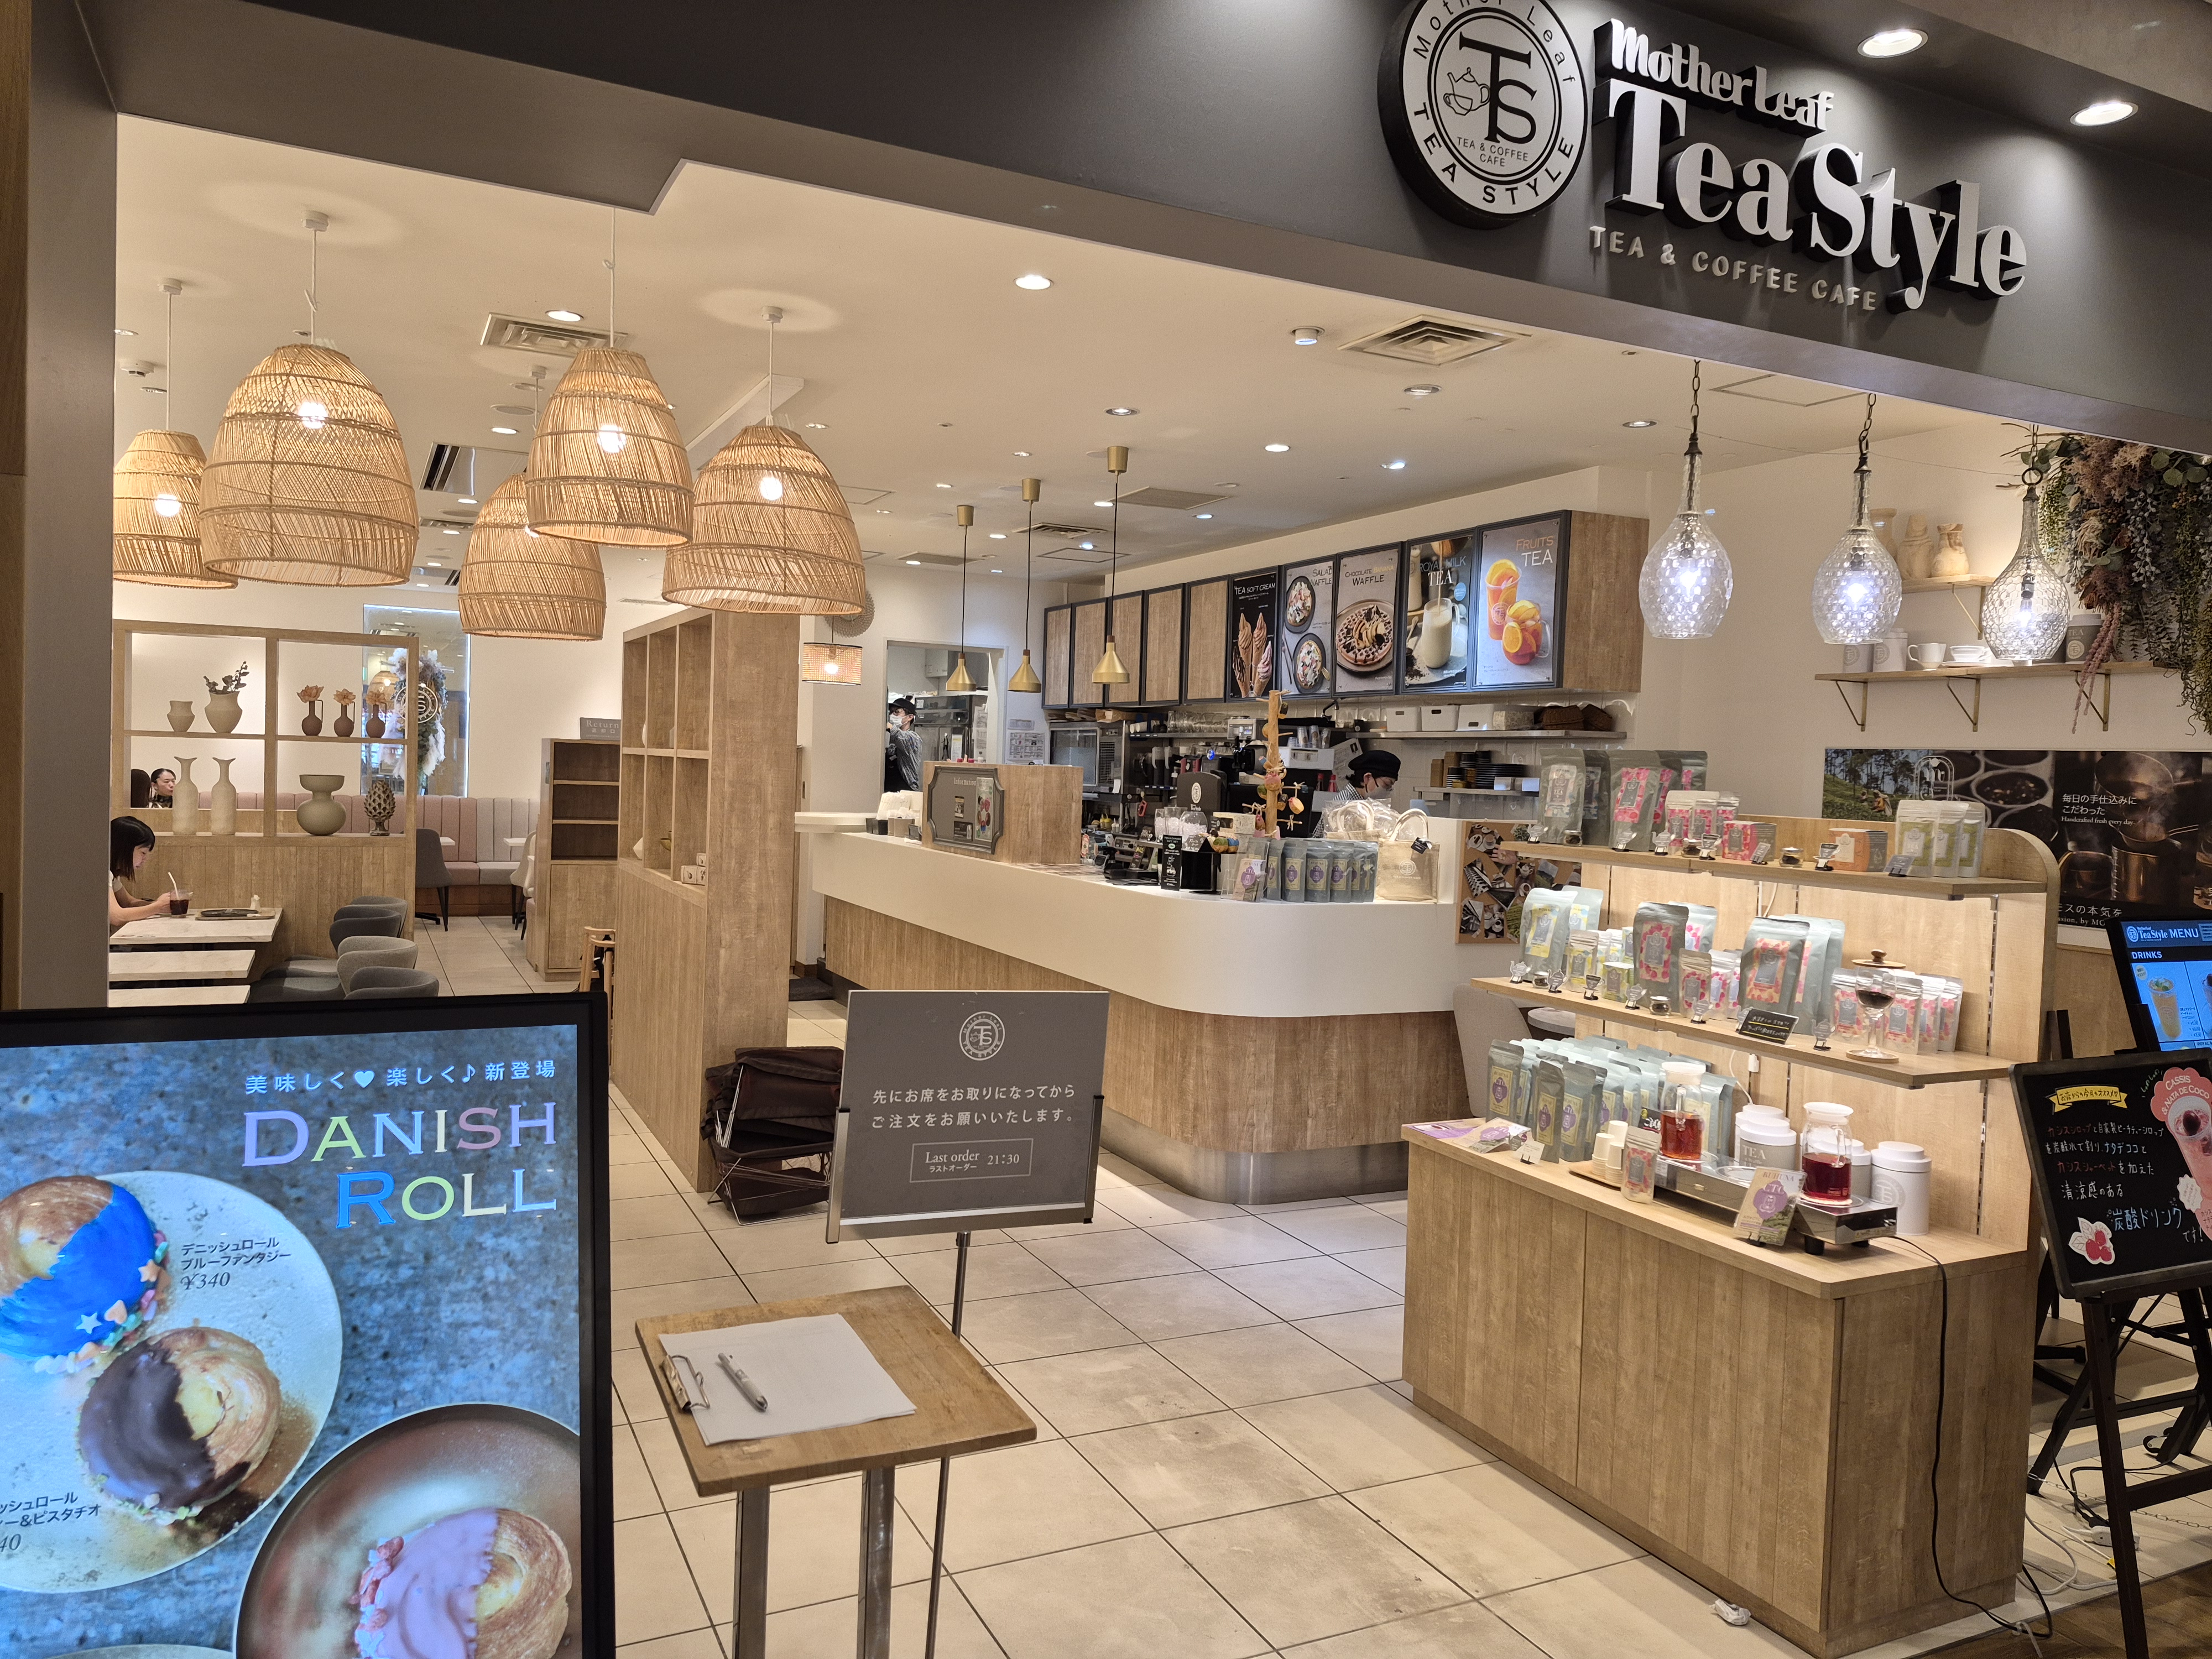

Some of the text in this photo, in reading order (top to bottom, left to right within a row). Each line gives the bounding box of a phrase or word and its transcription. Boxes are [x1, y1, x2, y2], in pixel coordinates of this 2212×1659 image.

[1527, 6, 1575, 83] Leaf
[1414, 102, 1574, 205] TEA STYLE
[1457, 136, 1529, 162] TEA & COFFEE
[1479, 153, 1505, 168] CAFE
[1589, 225, 1877, 311] TEA & COFFEE CAFE
[1516, 535, 1554, 551] FRUITS
[1420, 555, 1467, 572] ROYAL MILK
[1521, 549, 1553, 567] TEA
[1312, 568, 1332, 577] SALAD
[1345, 565, 1394, 578] CHOCOLATE BANANA
[1428, 569, 1453, 587] TEA
[1234, 582, 1276, 596] TEA SOFT CREAM
[1353, 575, 1385, 587] WAFFLE
[586, 719, 619, 729] Return
[2062, 794, 2137, 805] 毎日の手仕込みに
[2063, 805, 2106, 815] こだわった
[2080, 917, 2089, 926] by
[2169, 928, 2199, 938] MENU
[2131, 951, 2163, 959] DRINKS
[2166, 1075, 2191, 1091] CASSIS
[872, 1083, 1076, 1105] 先にお席をお取りになってから
[2162, 1085, 2210, 1115] & NATA DE COCO
[870, 1108, 1074, 1130] ご注文をお願いいたします。
[241, 1102, 557, 1168] DANISH
[925, 1149, 1020, 1166] Last order 21:30
[1743, 1145, 1766, 1160] TEA
[929, 1163, 977, 1173] ラストオーダー
[335, 1167, 557, 1229] ROLL
[2060, 1180, 2124, 1201] 清涼感のある
[2112, 1206, 2182, 1232] 炭酸ドリンク
[181, 1237, 280, 1256] デニッシュロール
[181, 1250, 291, 1271] ブルーファンタジー
[180, 1271, 231, 1290] ¥340
[0, 1504, 102, 1527] ー&ピスタチオ
